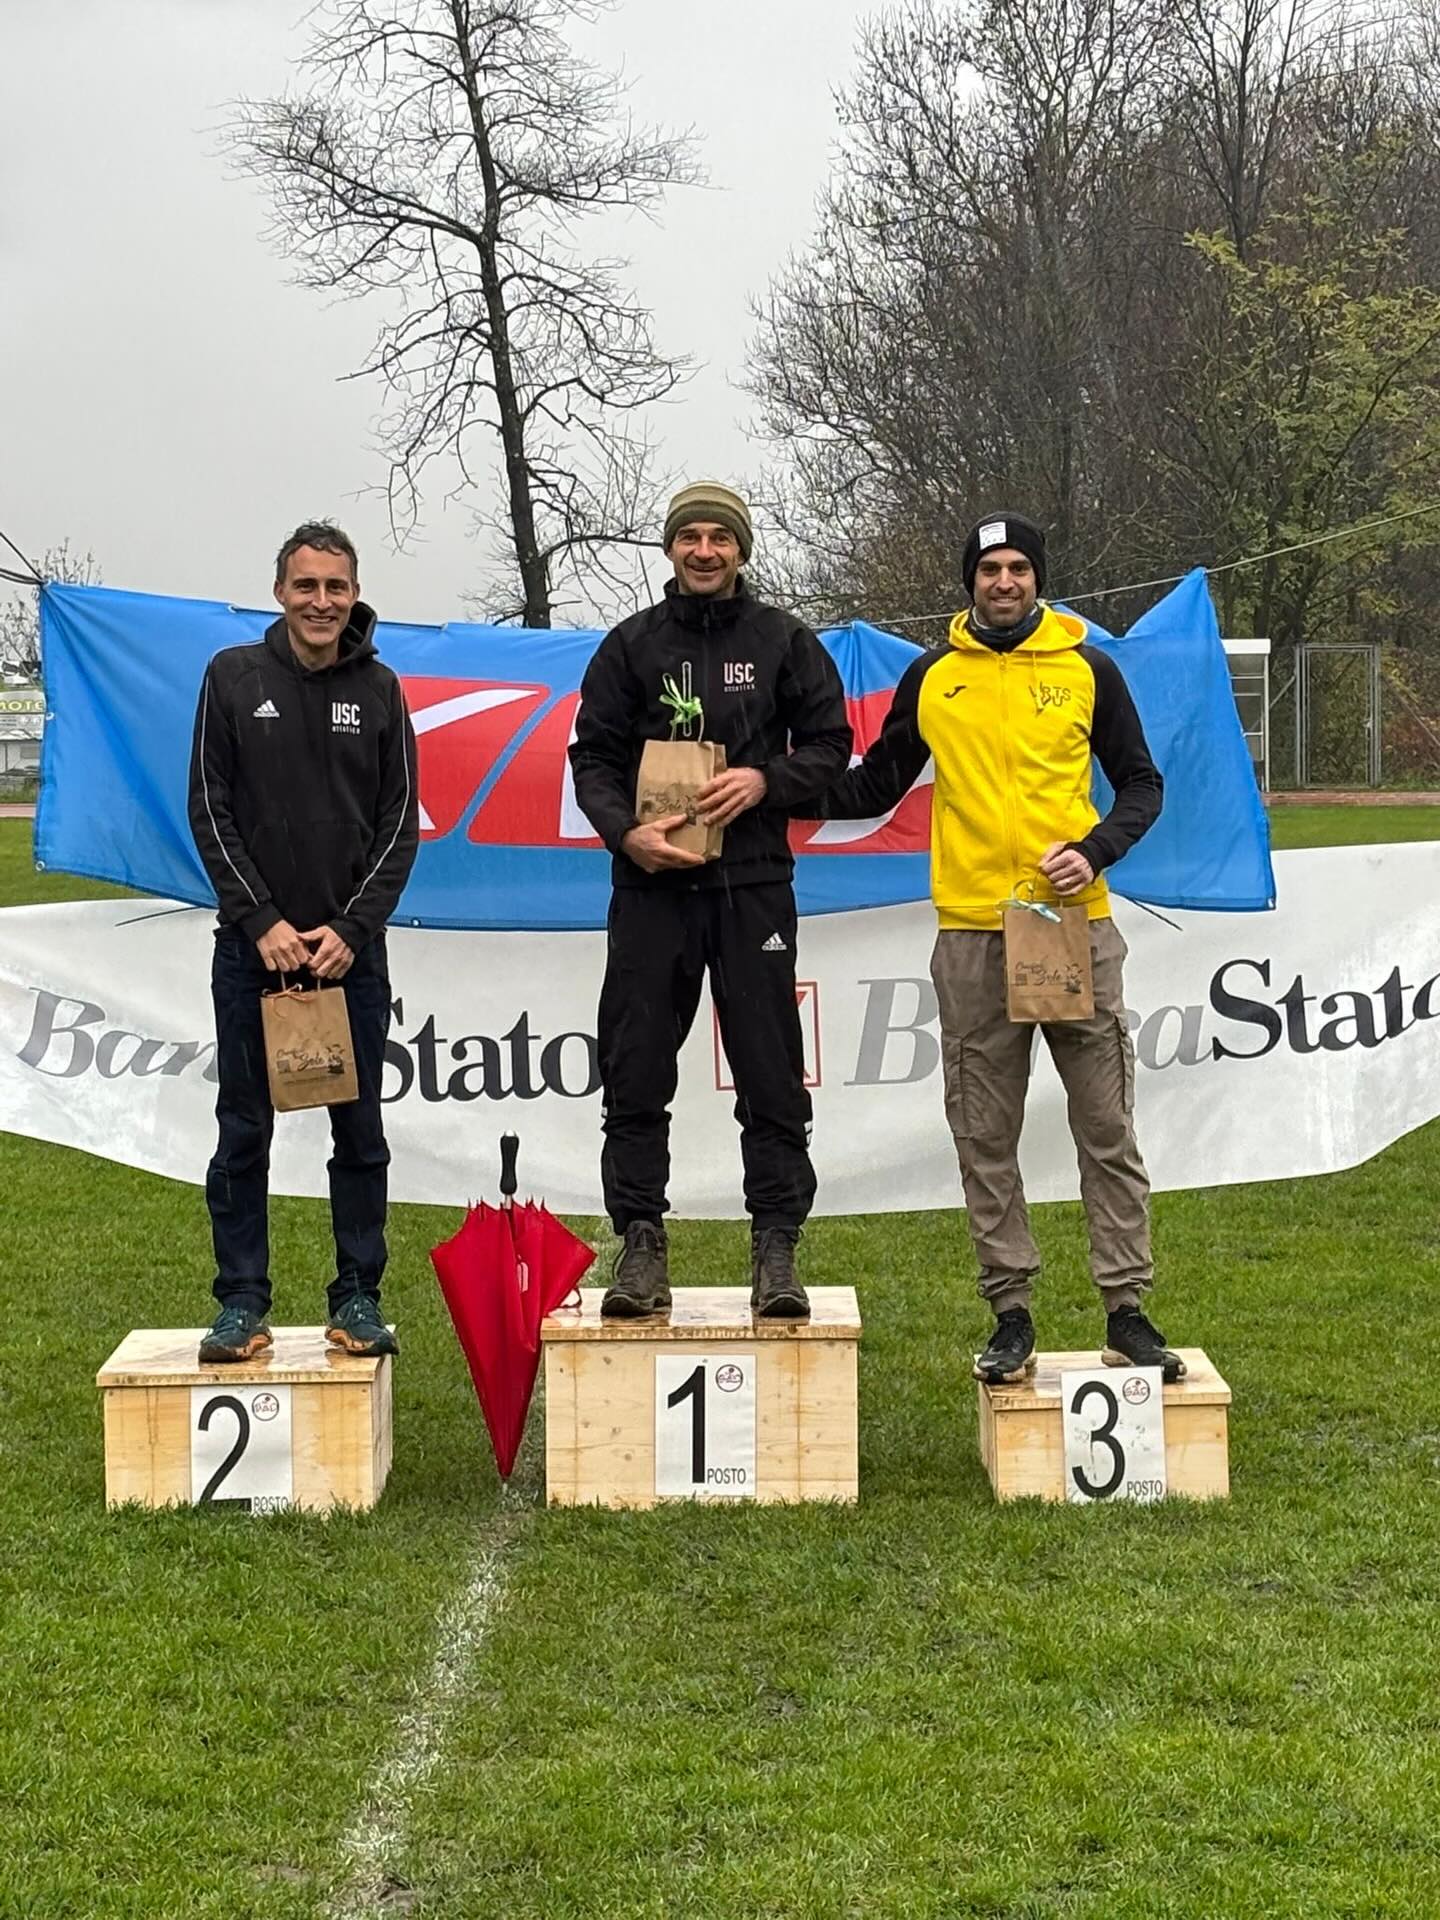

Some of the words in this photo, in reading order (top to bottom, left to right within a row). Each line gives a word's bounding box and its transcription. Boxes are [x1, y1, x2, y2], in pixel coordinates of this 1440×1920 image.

[724, 662, 755, 684] USC
[331, 702, 361, 726] USC
[667, 1365, 706, 1484] 1
[1071, 1381, 1125, 1498] 3
[198, 1395, 251, 1512] 2
[707, 1468, 746, 1484] POSTO
[1127, 1480, 1163, 1496] POSTO
[253, 1496, 289, 1512] POSTO
